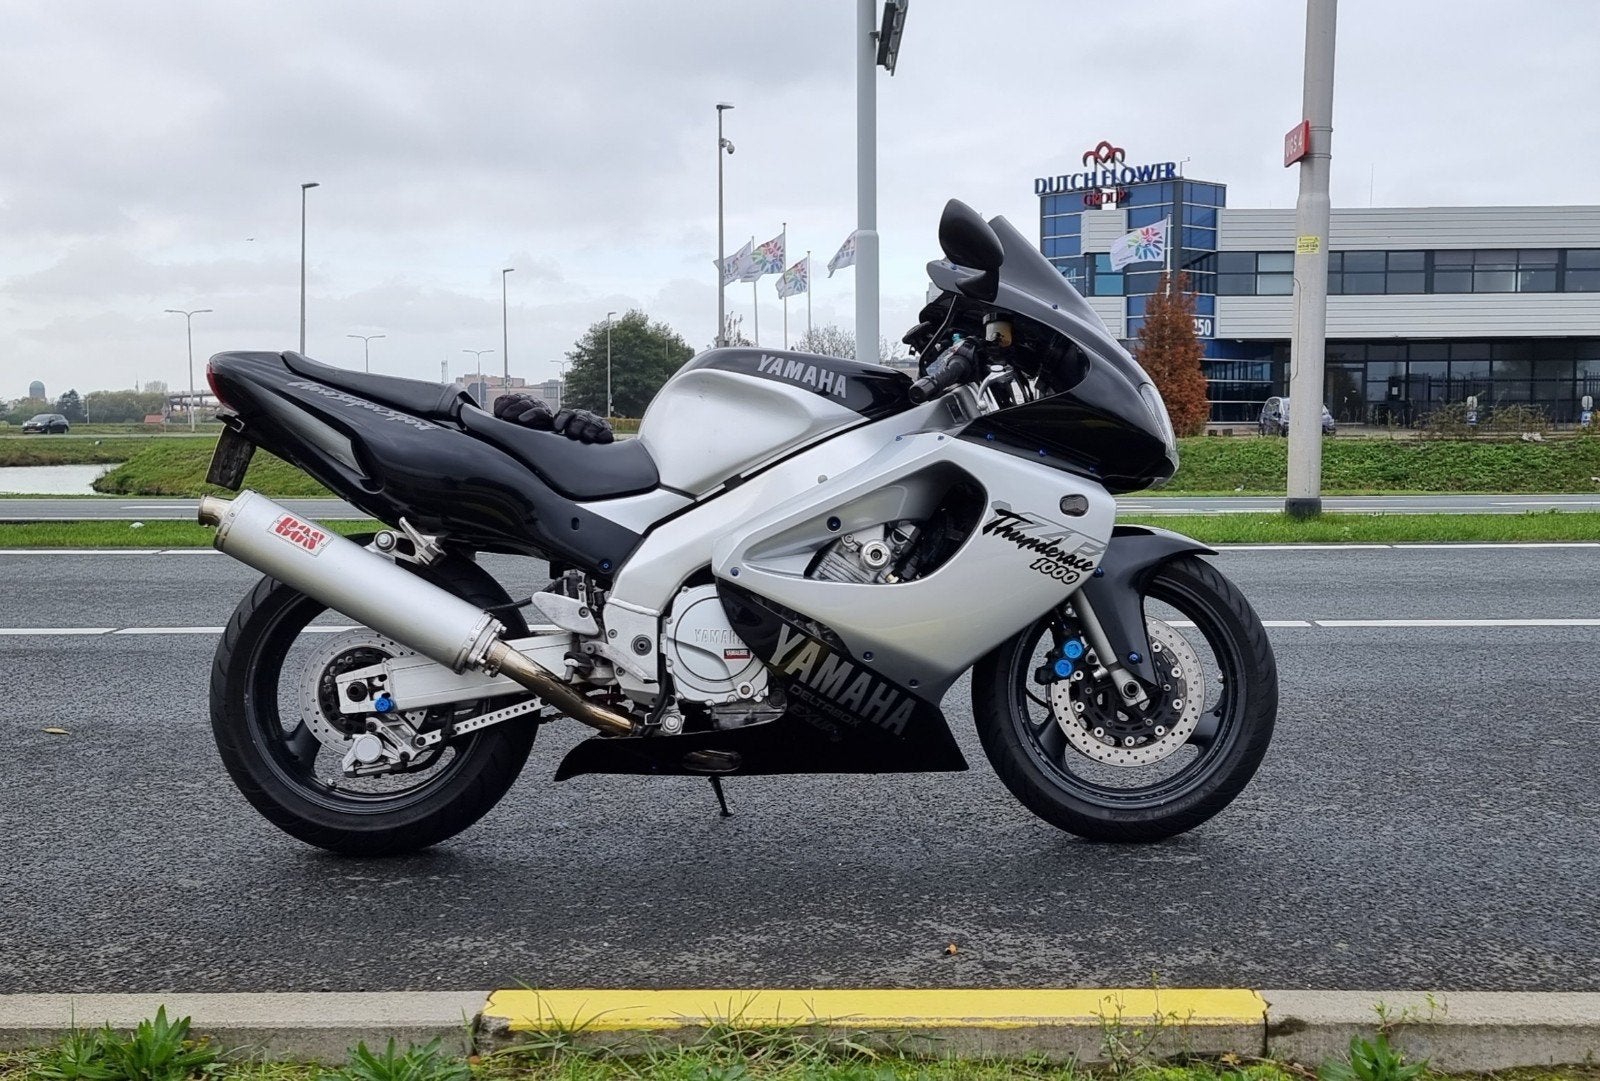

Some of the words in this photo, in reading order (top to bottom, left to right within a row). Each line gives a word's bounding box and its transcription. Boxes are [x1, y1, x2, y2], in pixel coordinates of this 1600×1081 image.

[1034, 171, 1097, 194] DUTCH
[1102, 162, 1177, 187] FLOWER
[1084, 187, 1127, 206] GROUP
[757, 354, 847, 399] YAMAHA
[982, 508, 1094, 572] Thunderace
[1030, 558, 1080, 584] 1000
[769, 623, 917, 736] YAMAHA
[789, 683, 862, 728] DELTABOX
